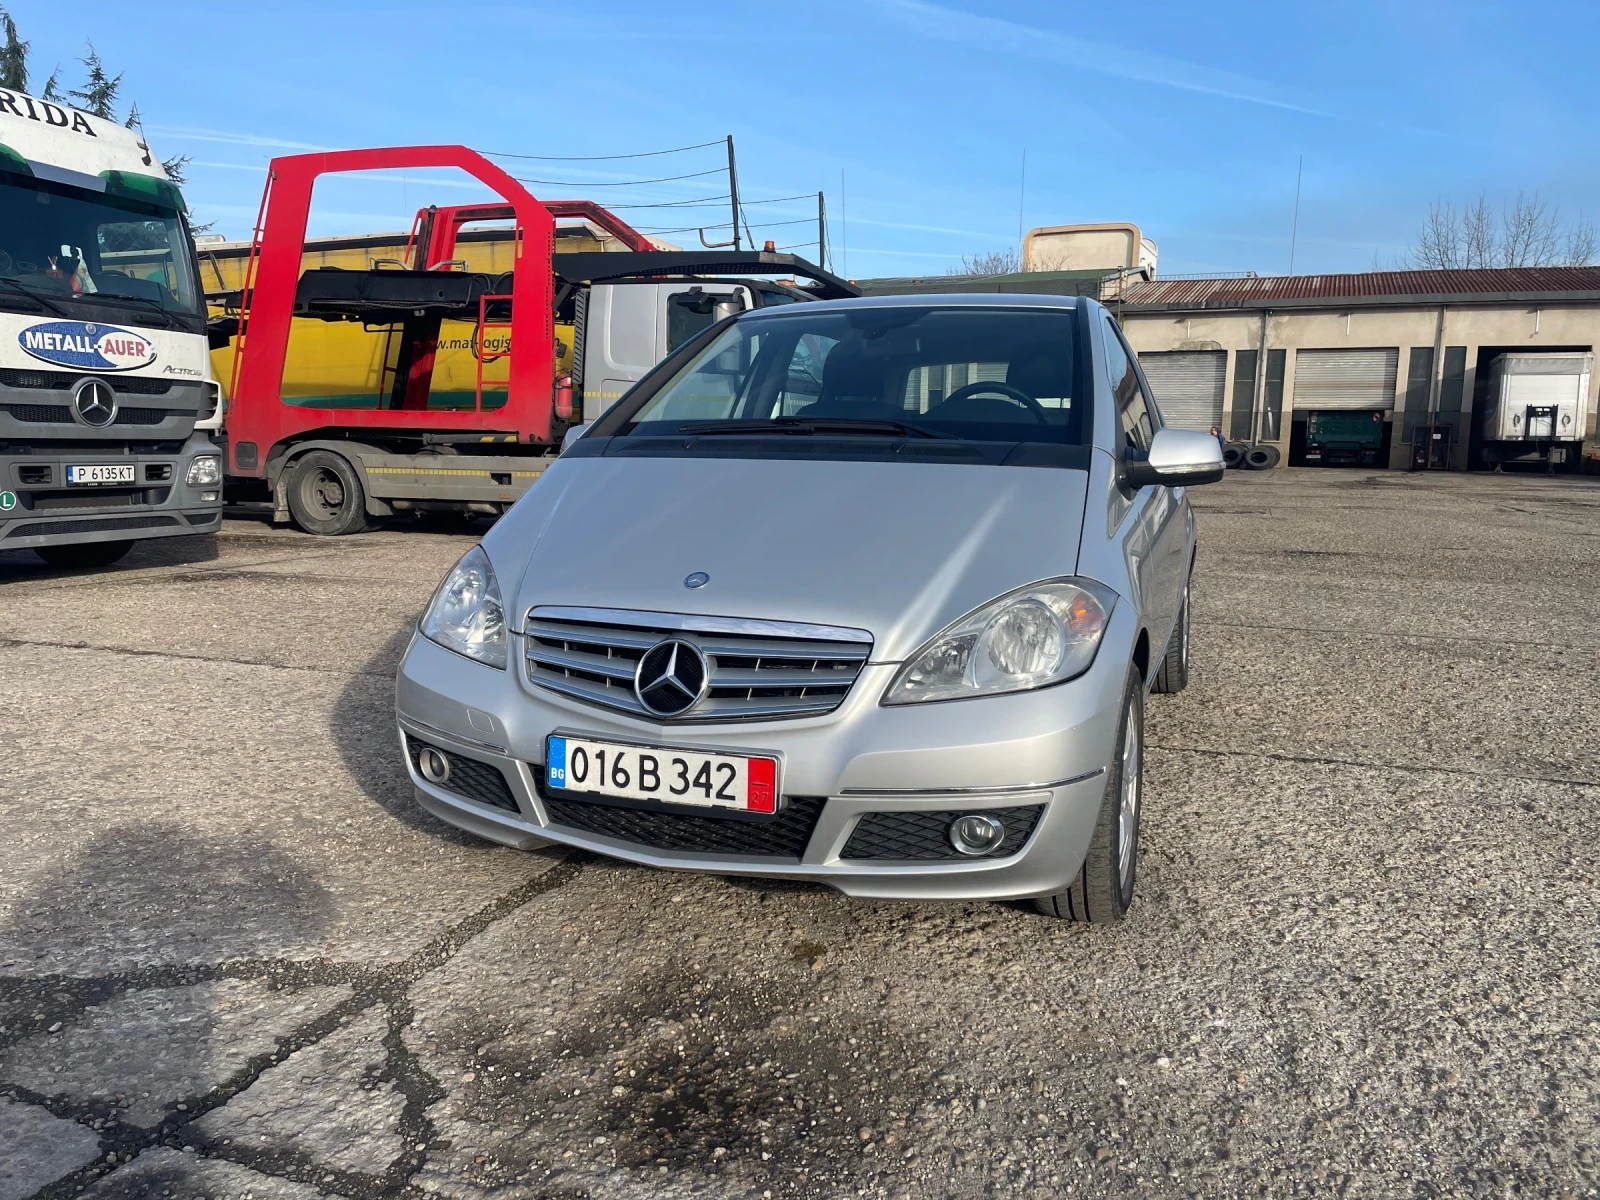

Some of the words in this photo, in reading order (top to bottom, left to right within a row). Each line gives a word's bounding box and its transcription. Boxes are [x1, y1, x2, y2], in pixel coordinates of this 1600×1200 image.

[25, 331, 146, 358] METALL-AUER
[3, 494, 12, 507] L
[551, 767, 565, 780] BG
[751, 791, 769, 805] 27
